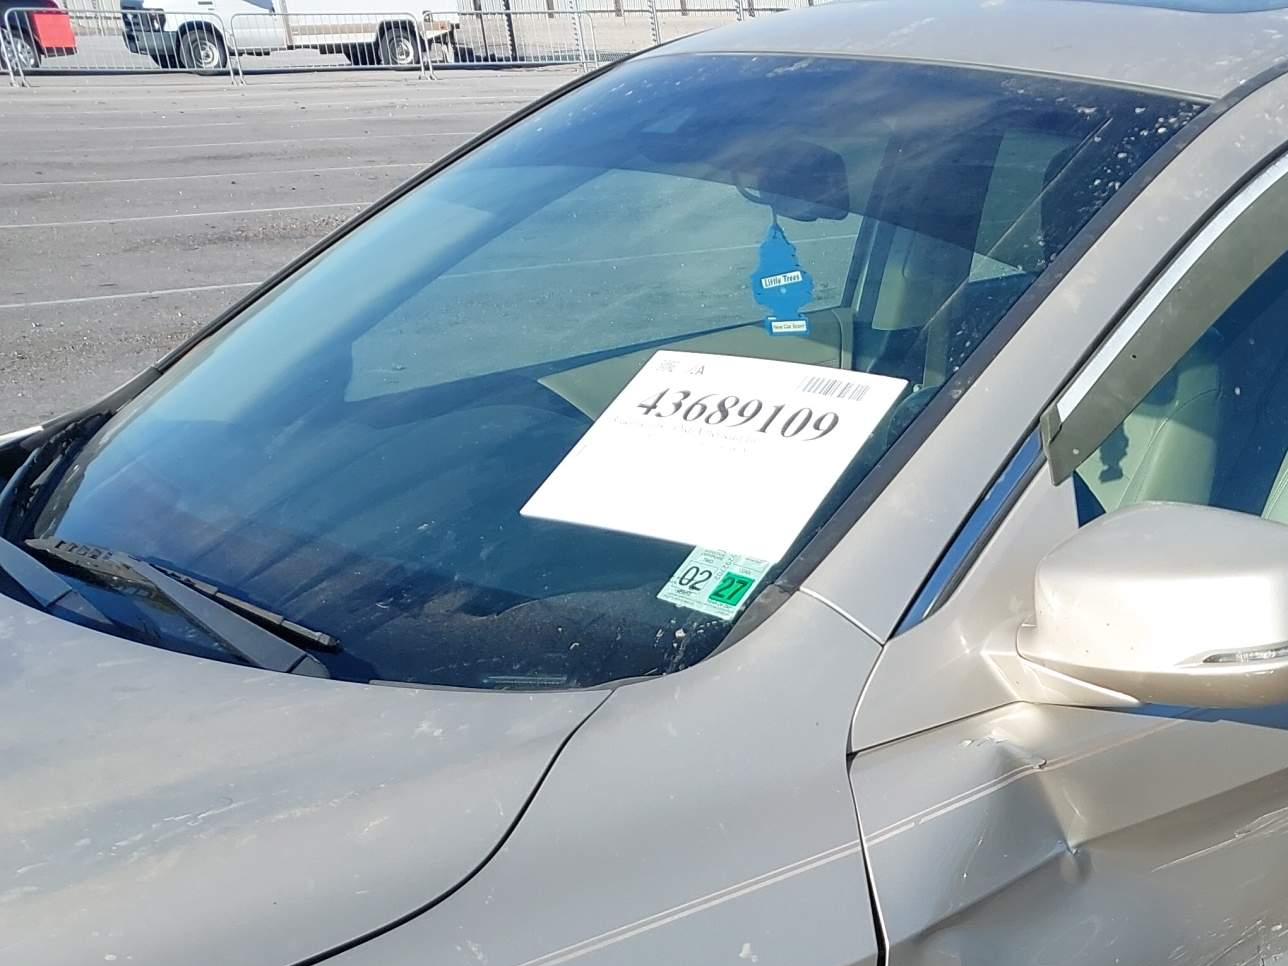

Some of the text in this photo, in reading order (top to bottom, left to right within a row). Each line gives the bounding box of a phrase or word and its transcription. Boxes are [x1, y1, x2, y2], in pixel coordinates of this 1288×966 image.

[636, 387, 840, 442] 43689109
[678, 565, 713, 592] 02
[709, 576, 749, 601] 27
